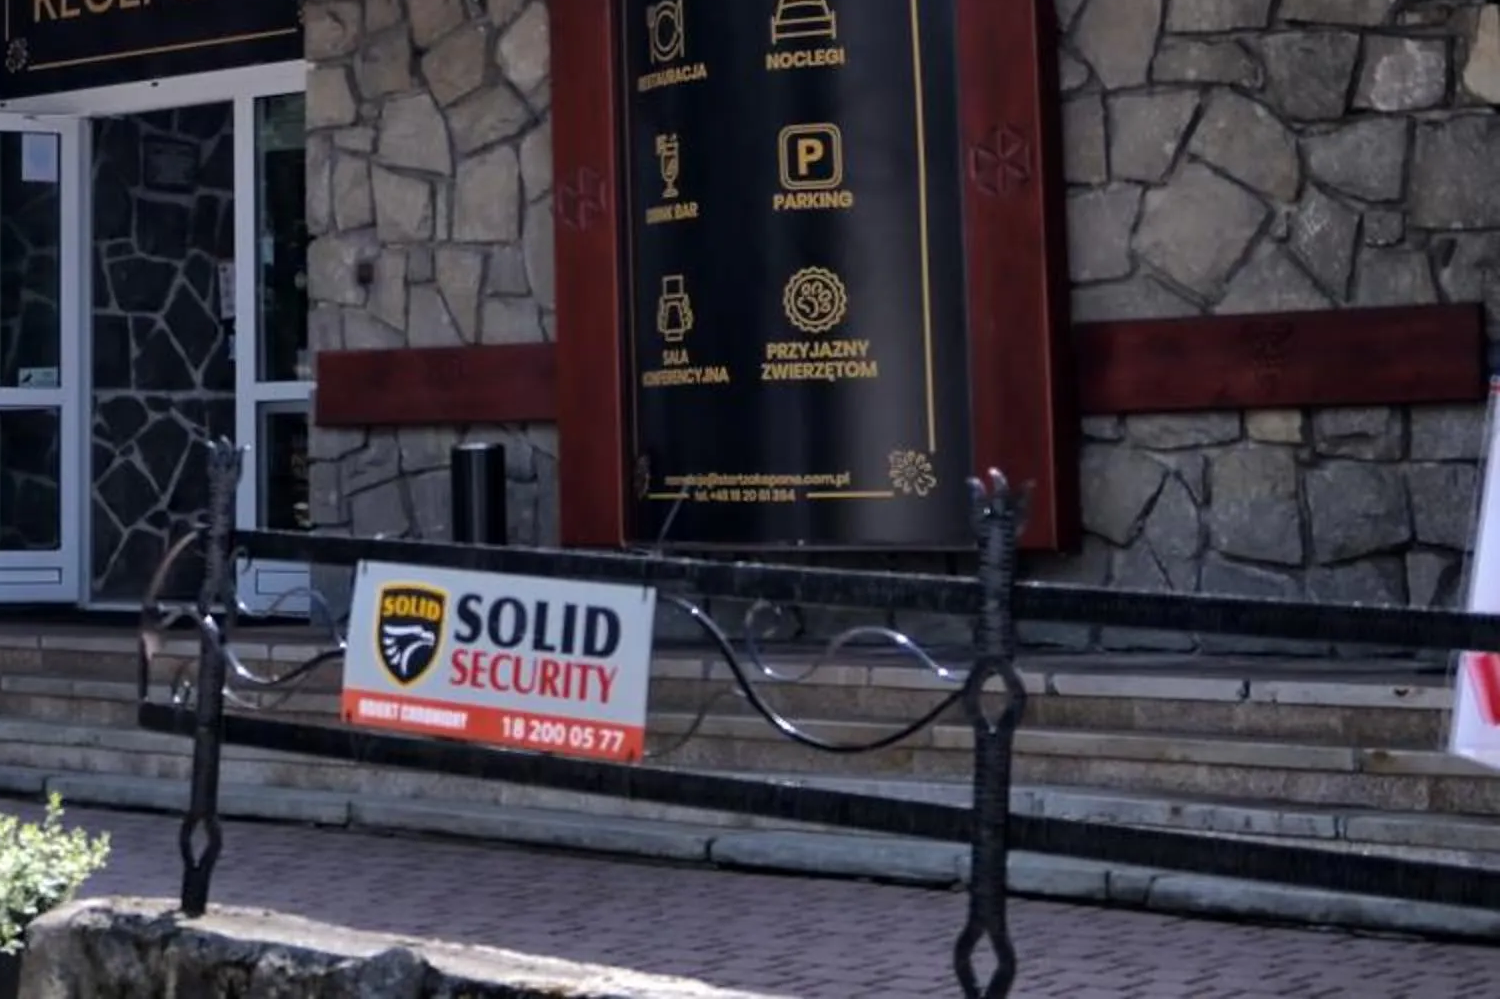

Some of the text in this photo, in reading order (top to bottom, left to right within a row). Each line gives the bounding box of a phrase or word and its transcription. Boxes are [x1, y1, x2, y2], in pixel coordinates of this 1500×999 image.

[766, 47, 845, 70] NOCLEGI
[773, 191, 852, 210] PARKING
[766, 340, 869, 360] PRZYJAZNY
[761, 361, 878, 382] ZWIERZĘTOM
[382, 594, 440, 620] SOLID
[453, 593, 622, 659] SOLID
[450, 649, 618, 704] SECURITY
[502, 715, 625, 752] 18 200 05 77
